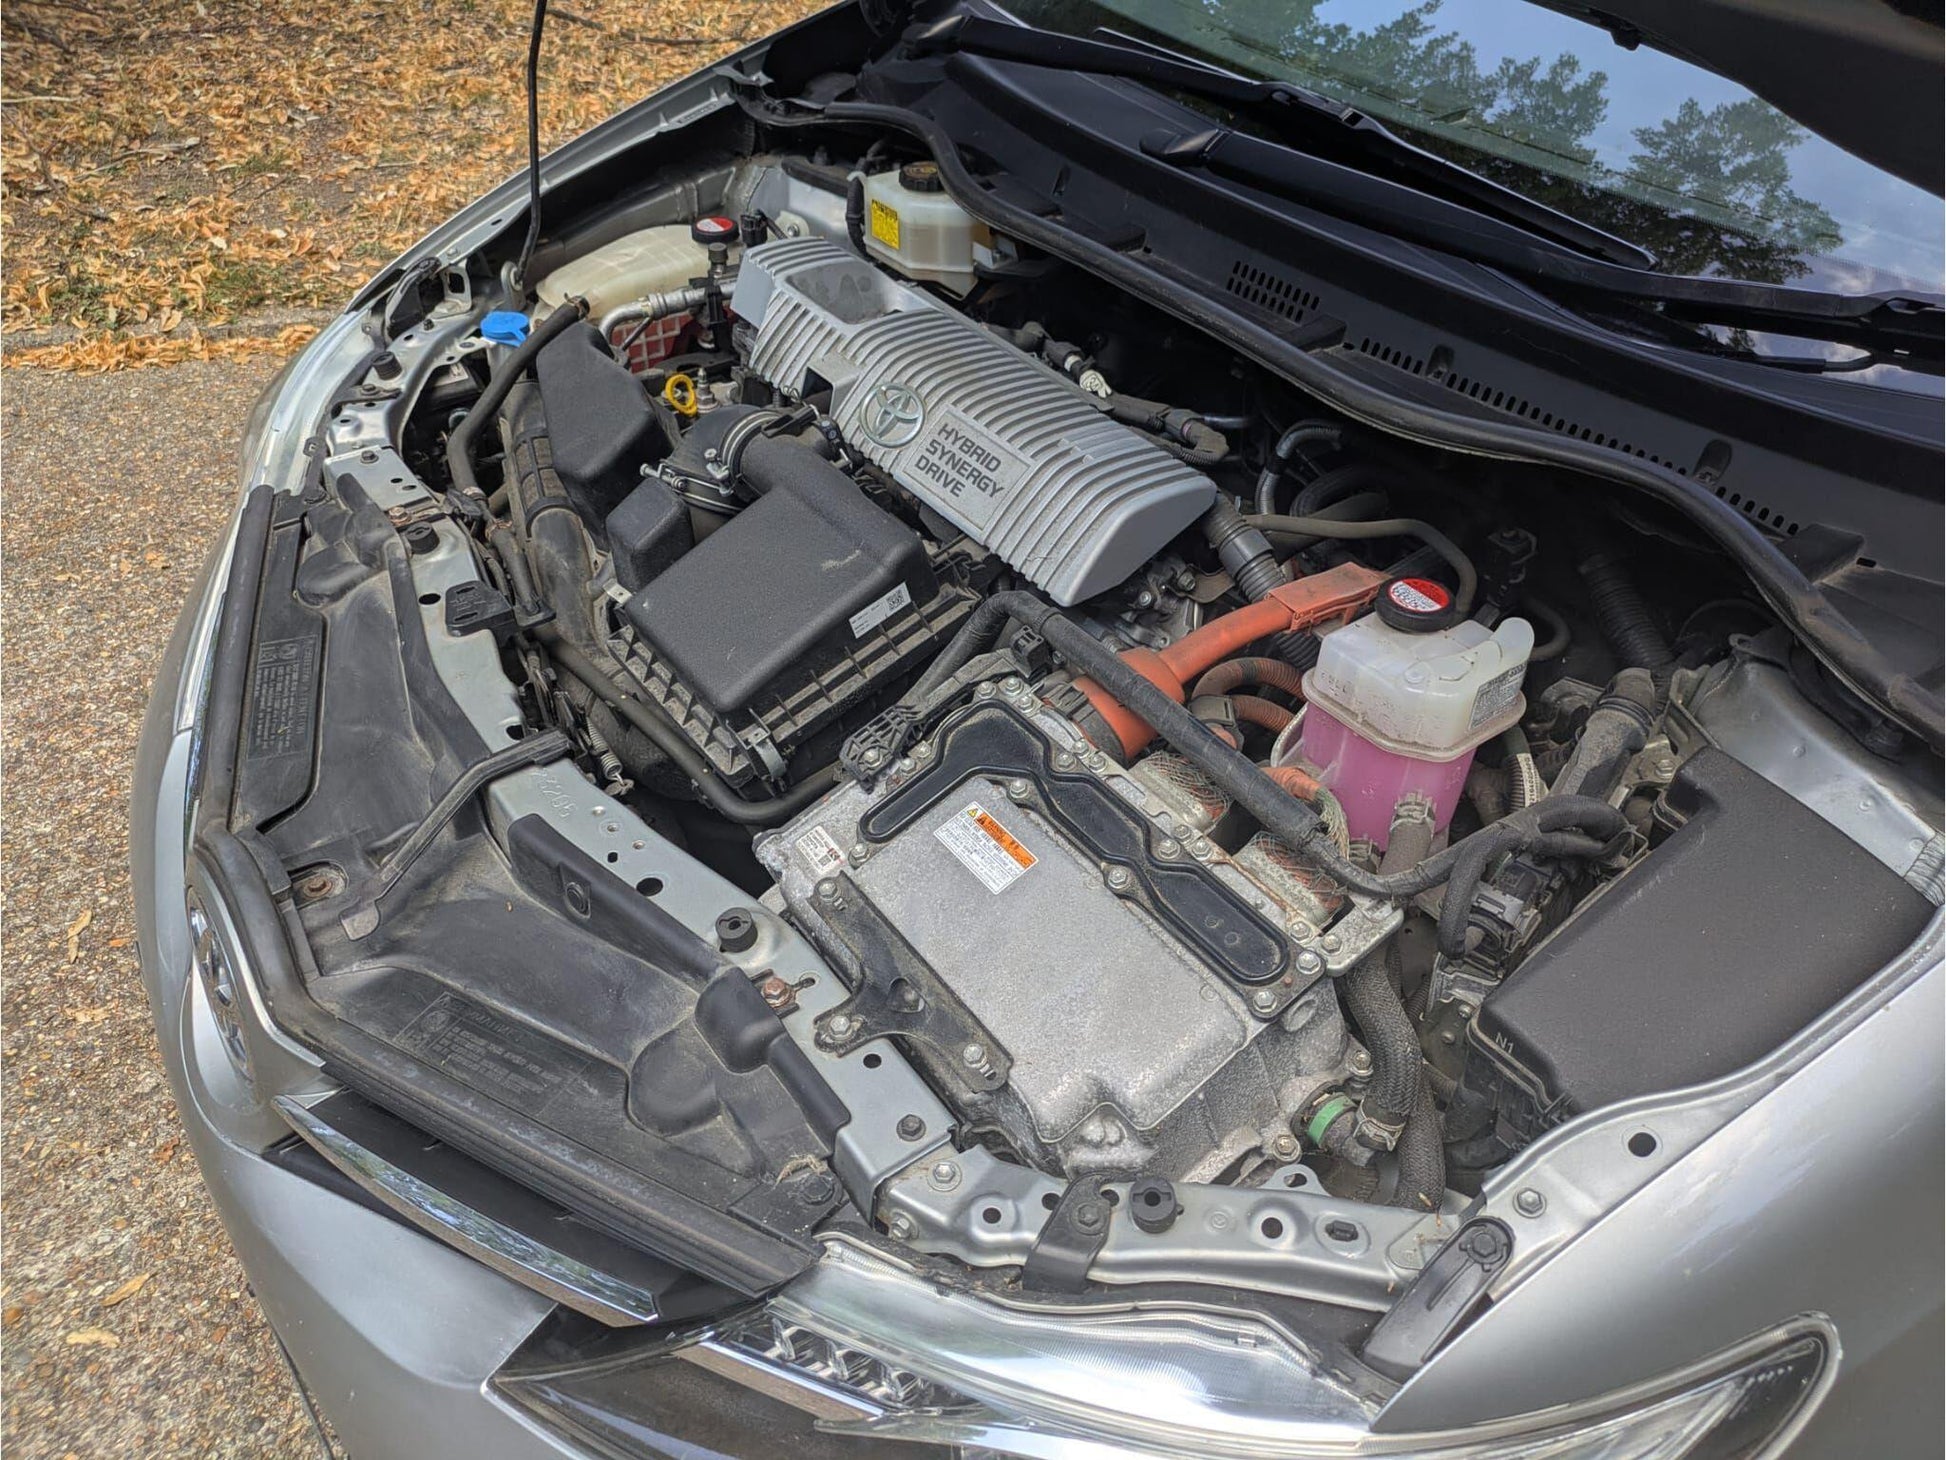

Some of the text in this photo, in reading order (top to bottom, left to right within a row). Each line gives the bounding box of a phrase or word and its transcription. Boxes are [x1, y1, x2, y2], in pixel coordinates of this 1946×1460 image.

[925, 439, 1005, 498] SYNERGY
[937, 423, 1001, 473] HYBRID
[914, 455, 966, 497] DRIVE
[1495, 1032, 1514, 1054] N1
